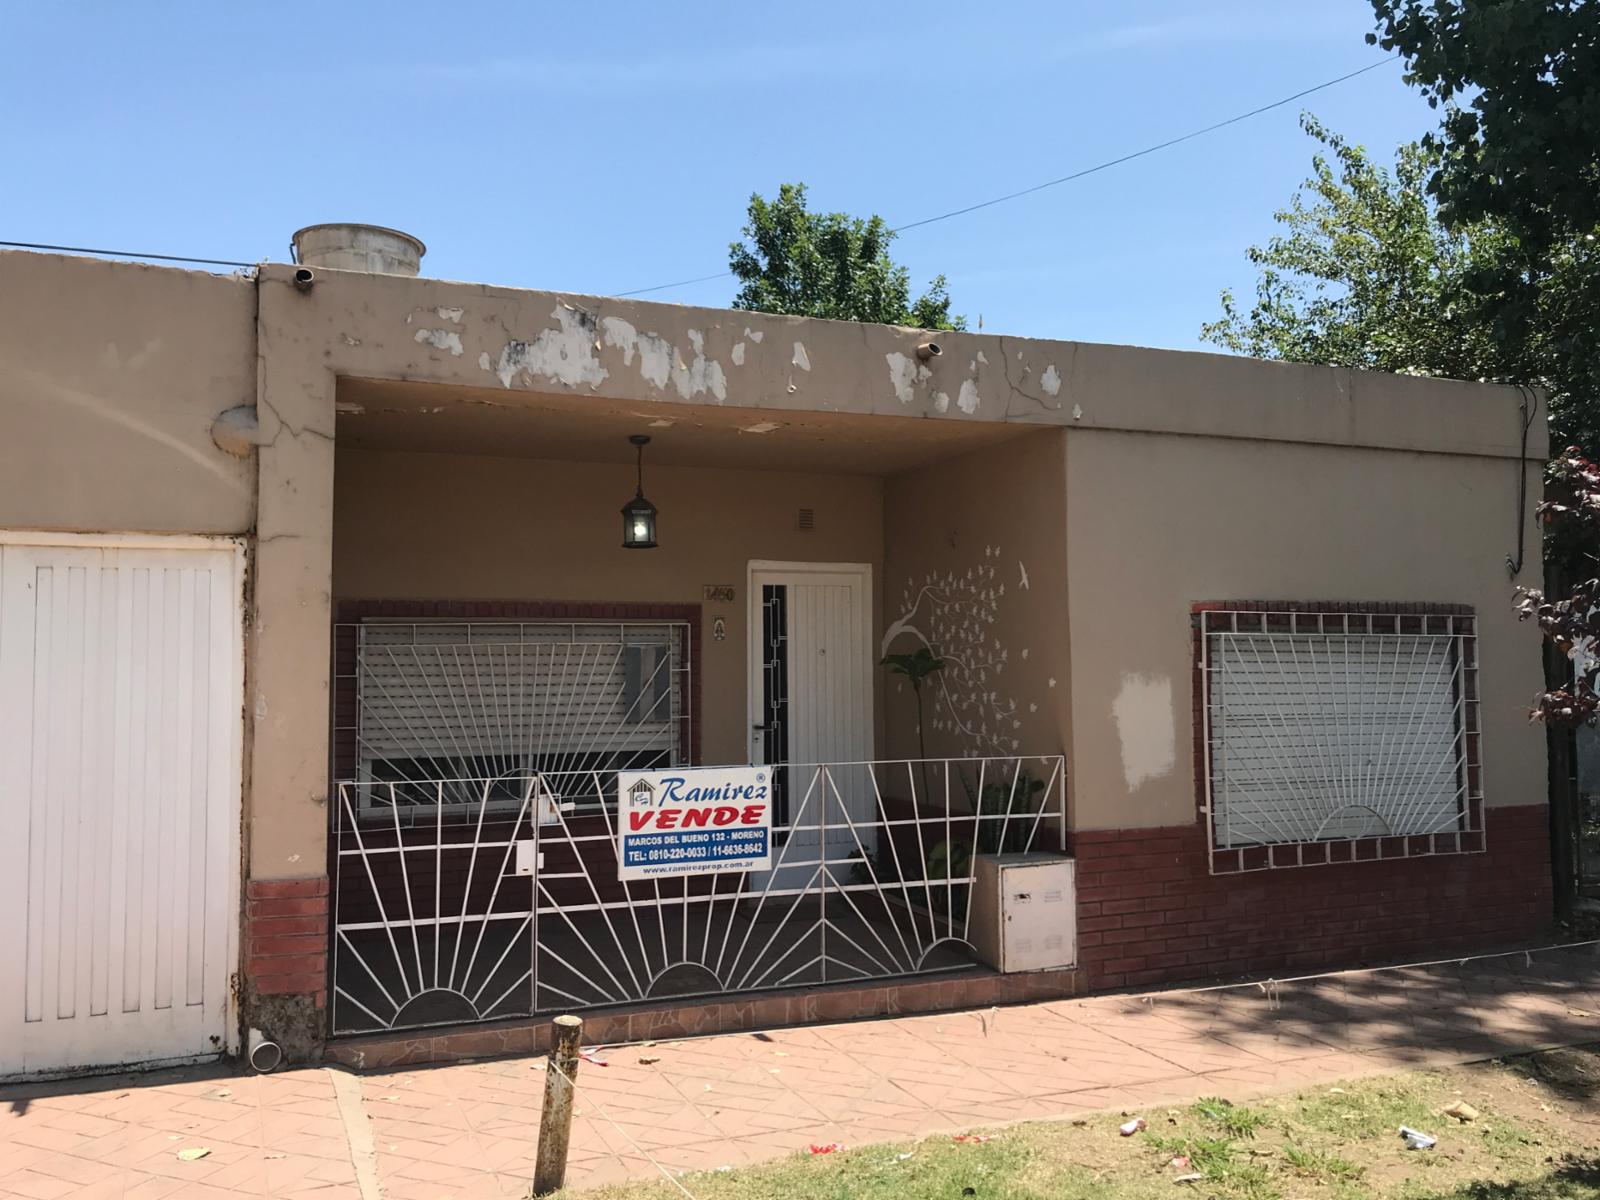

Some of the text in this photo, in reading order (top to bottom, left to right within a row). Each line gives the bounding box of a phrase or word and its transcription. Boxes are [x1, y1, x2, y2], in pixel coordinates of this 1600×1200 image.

[658, 778, 767, 807] Ramirez
[630, 805, 766, 831] VENDE
[628, 835, 662, 846] MARCOS
[665, 836, 679, 844] DEL
[682, 834, 709, 842] BUENO
[712, 832, 725, 841] 132
[732, 831, 764, 839] MORENO
[629, 851, 647, 861] TEL:
[649, 847, 706, 860] 0810-220-0033
[643, 861, 754, 874] www.ramirezprop.com.ar
